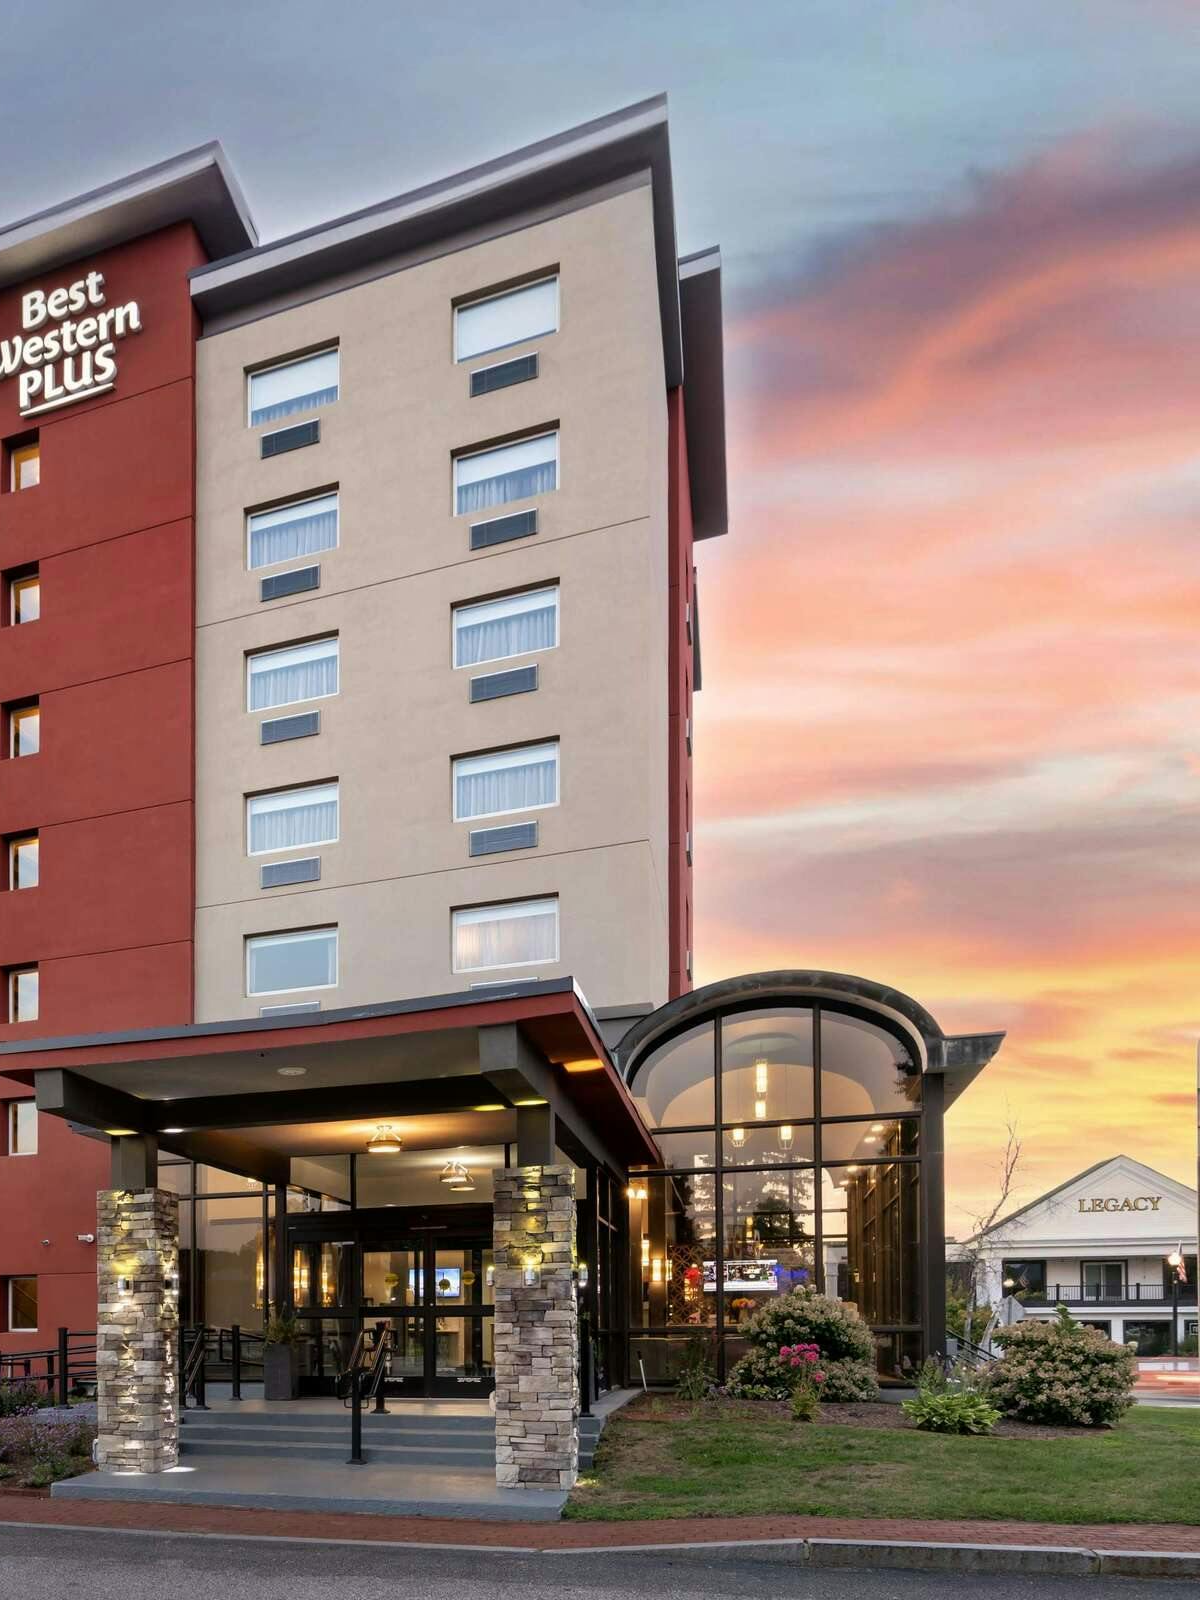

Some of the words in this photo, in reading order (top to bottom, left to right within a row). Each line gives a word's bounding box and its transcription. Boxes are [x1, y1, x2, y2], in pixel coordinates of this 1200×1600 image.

[21, 271, 104, 330] Best
[19, 342, 117, 409] PLUS
[1078, 1196, 1162, 1213] LEGACY
